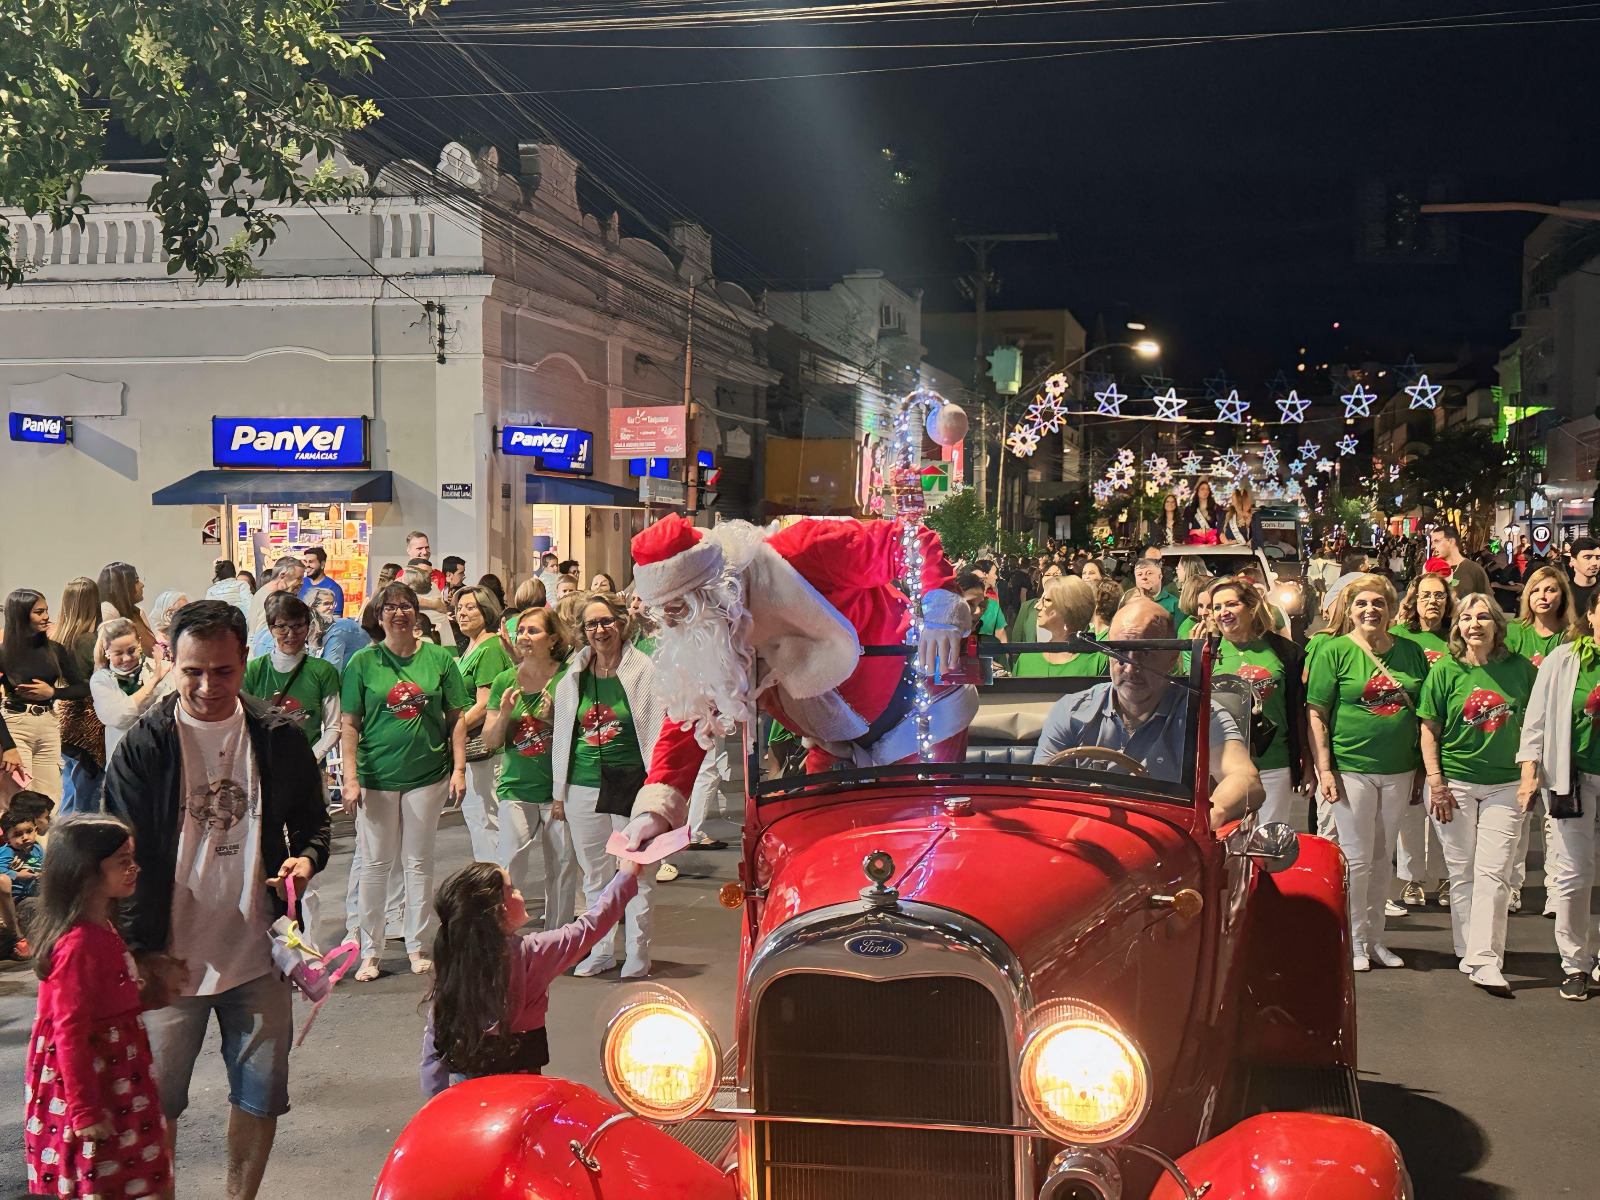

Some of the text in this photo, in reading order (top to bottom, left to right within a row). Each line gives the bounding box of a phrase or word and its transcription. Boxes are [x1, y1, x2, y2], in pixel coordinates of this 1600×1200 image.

[22, 417, 61, 433] PanVel
[230, 425, 346, 451] PanVel
[510, 431, 569, 448] PanVel
[294, 451, 338, 460] FARMÁCIAS
[860, 940, 892, 953] Ford
